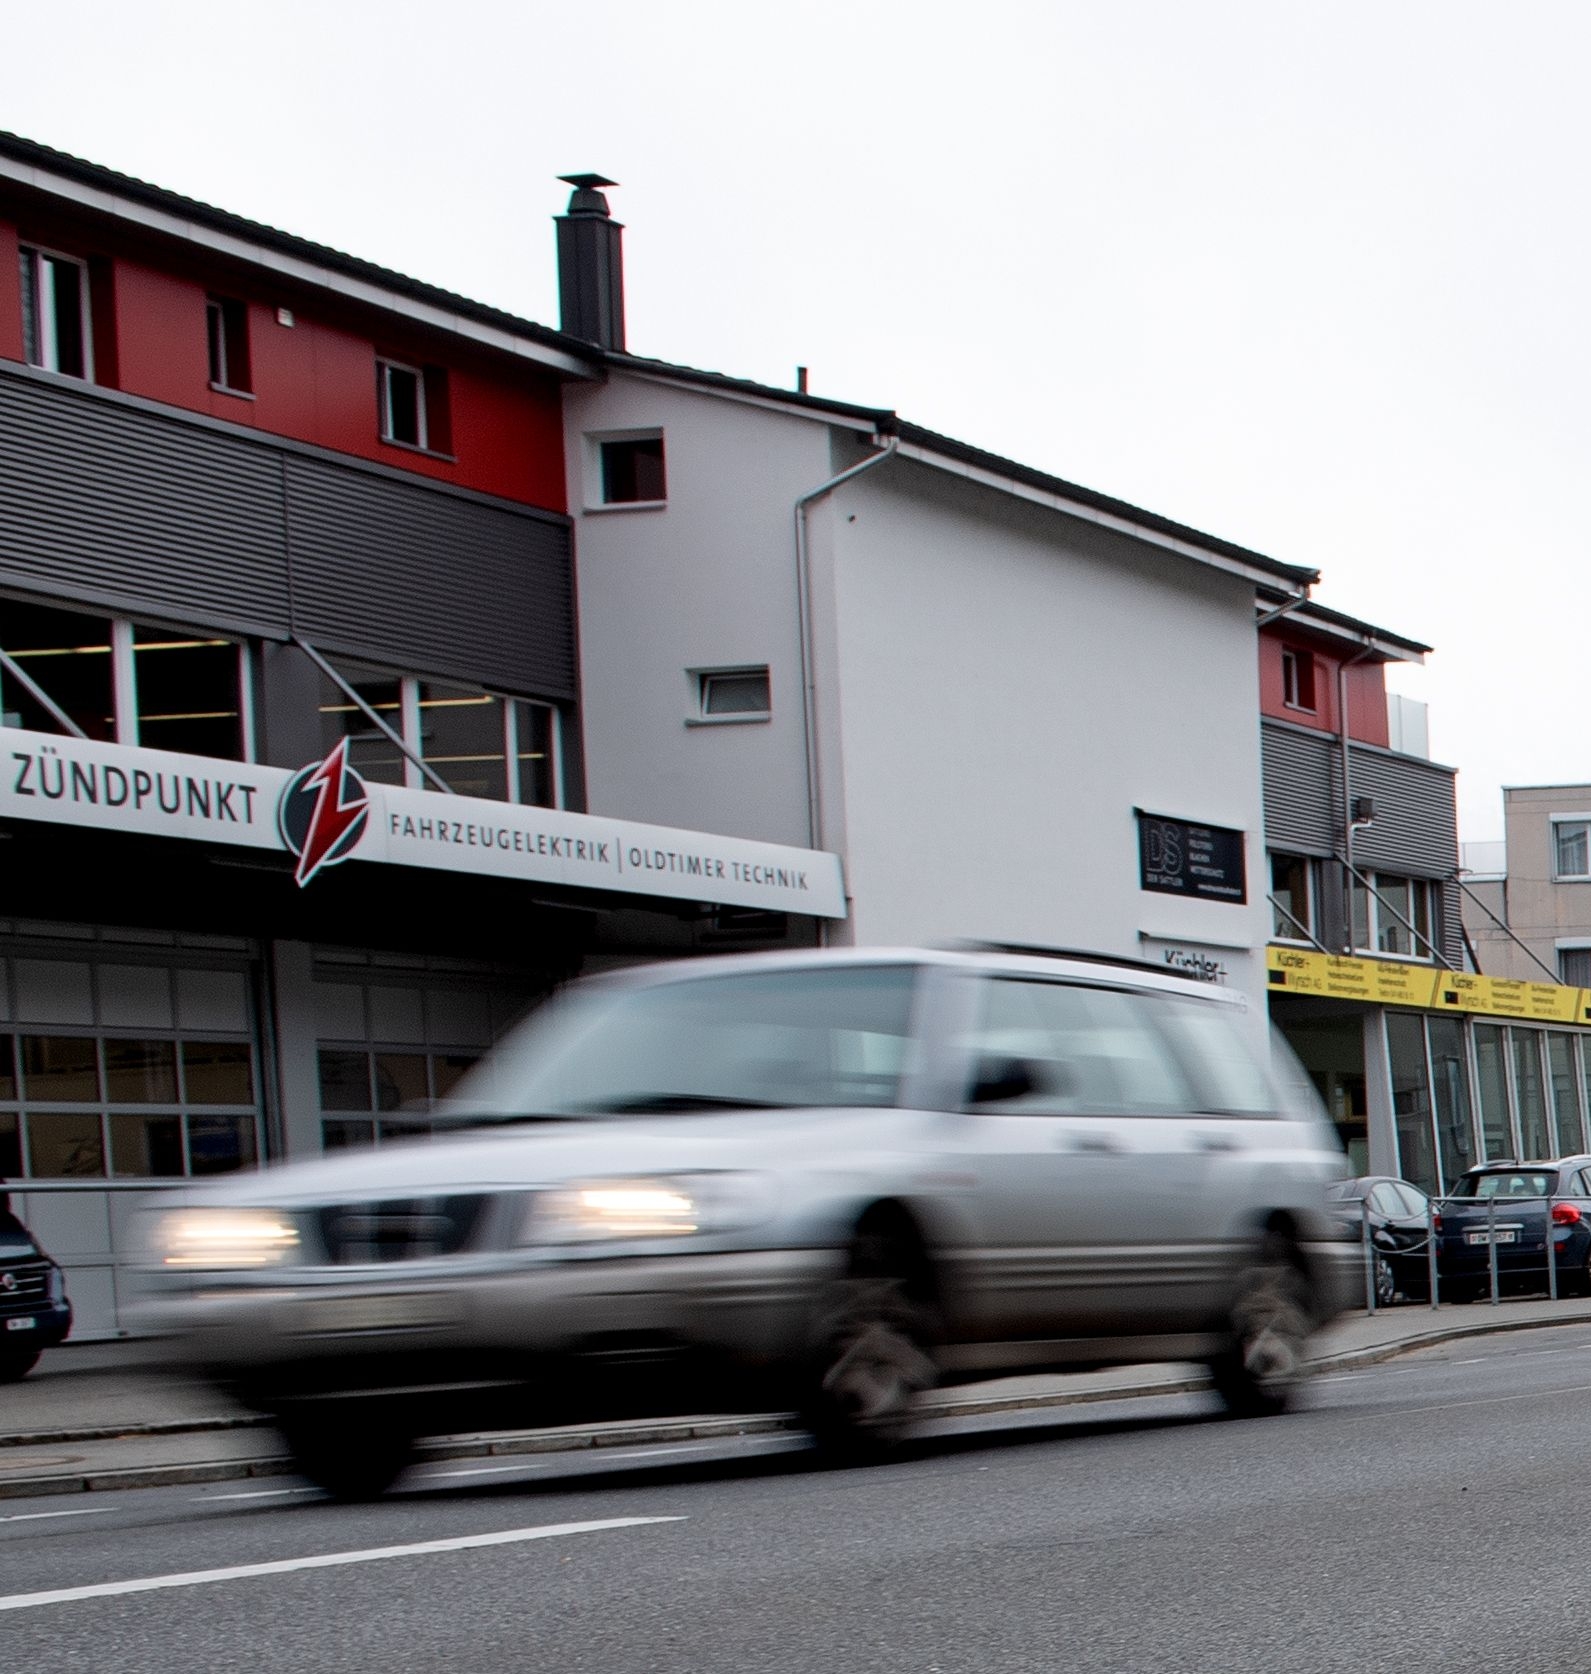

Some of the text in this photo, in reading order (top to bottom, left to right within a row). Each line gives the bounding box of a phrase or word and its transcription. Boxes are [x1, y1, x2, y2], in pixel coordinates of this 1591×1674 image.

[13, 746, 610, 863] ZÜNDPUNKT FAHRZEUGELEKTRIK
[629, 847, 808, 890] OLDTIMER TECHNIK
